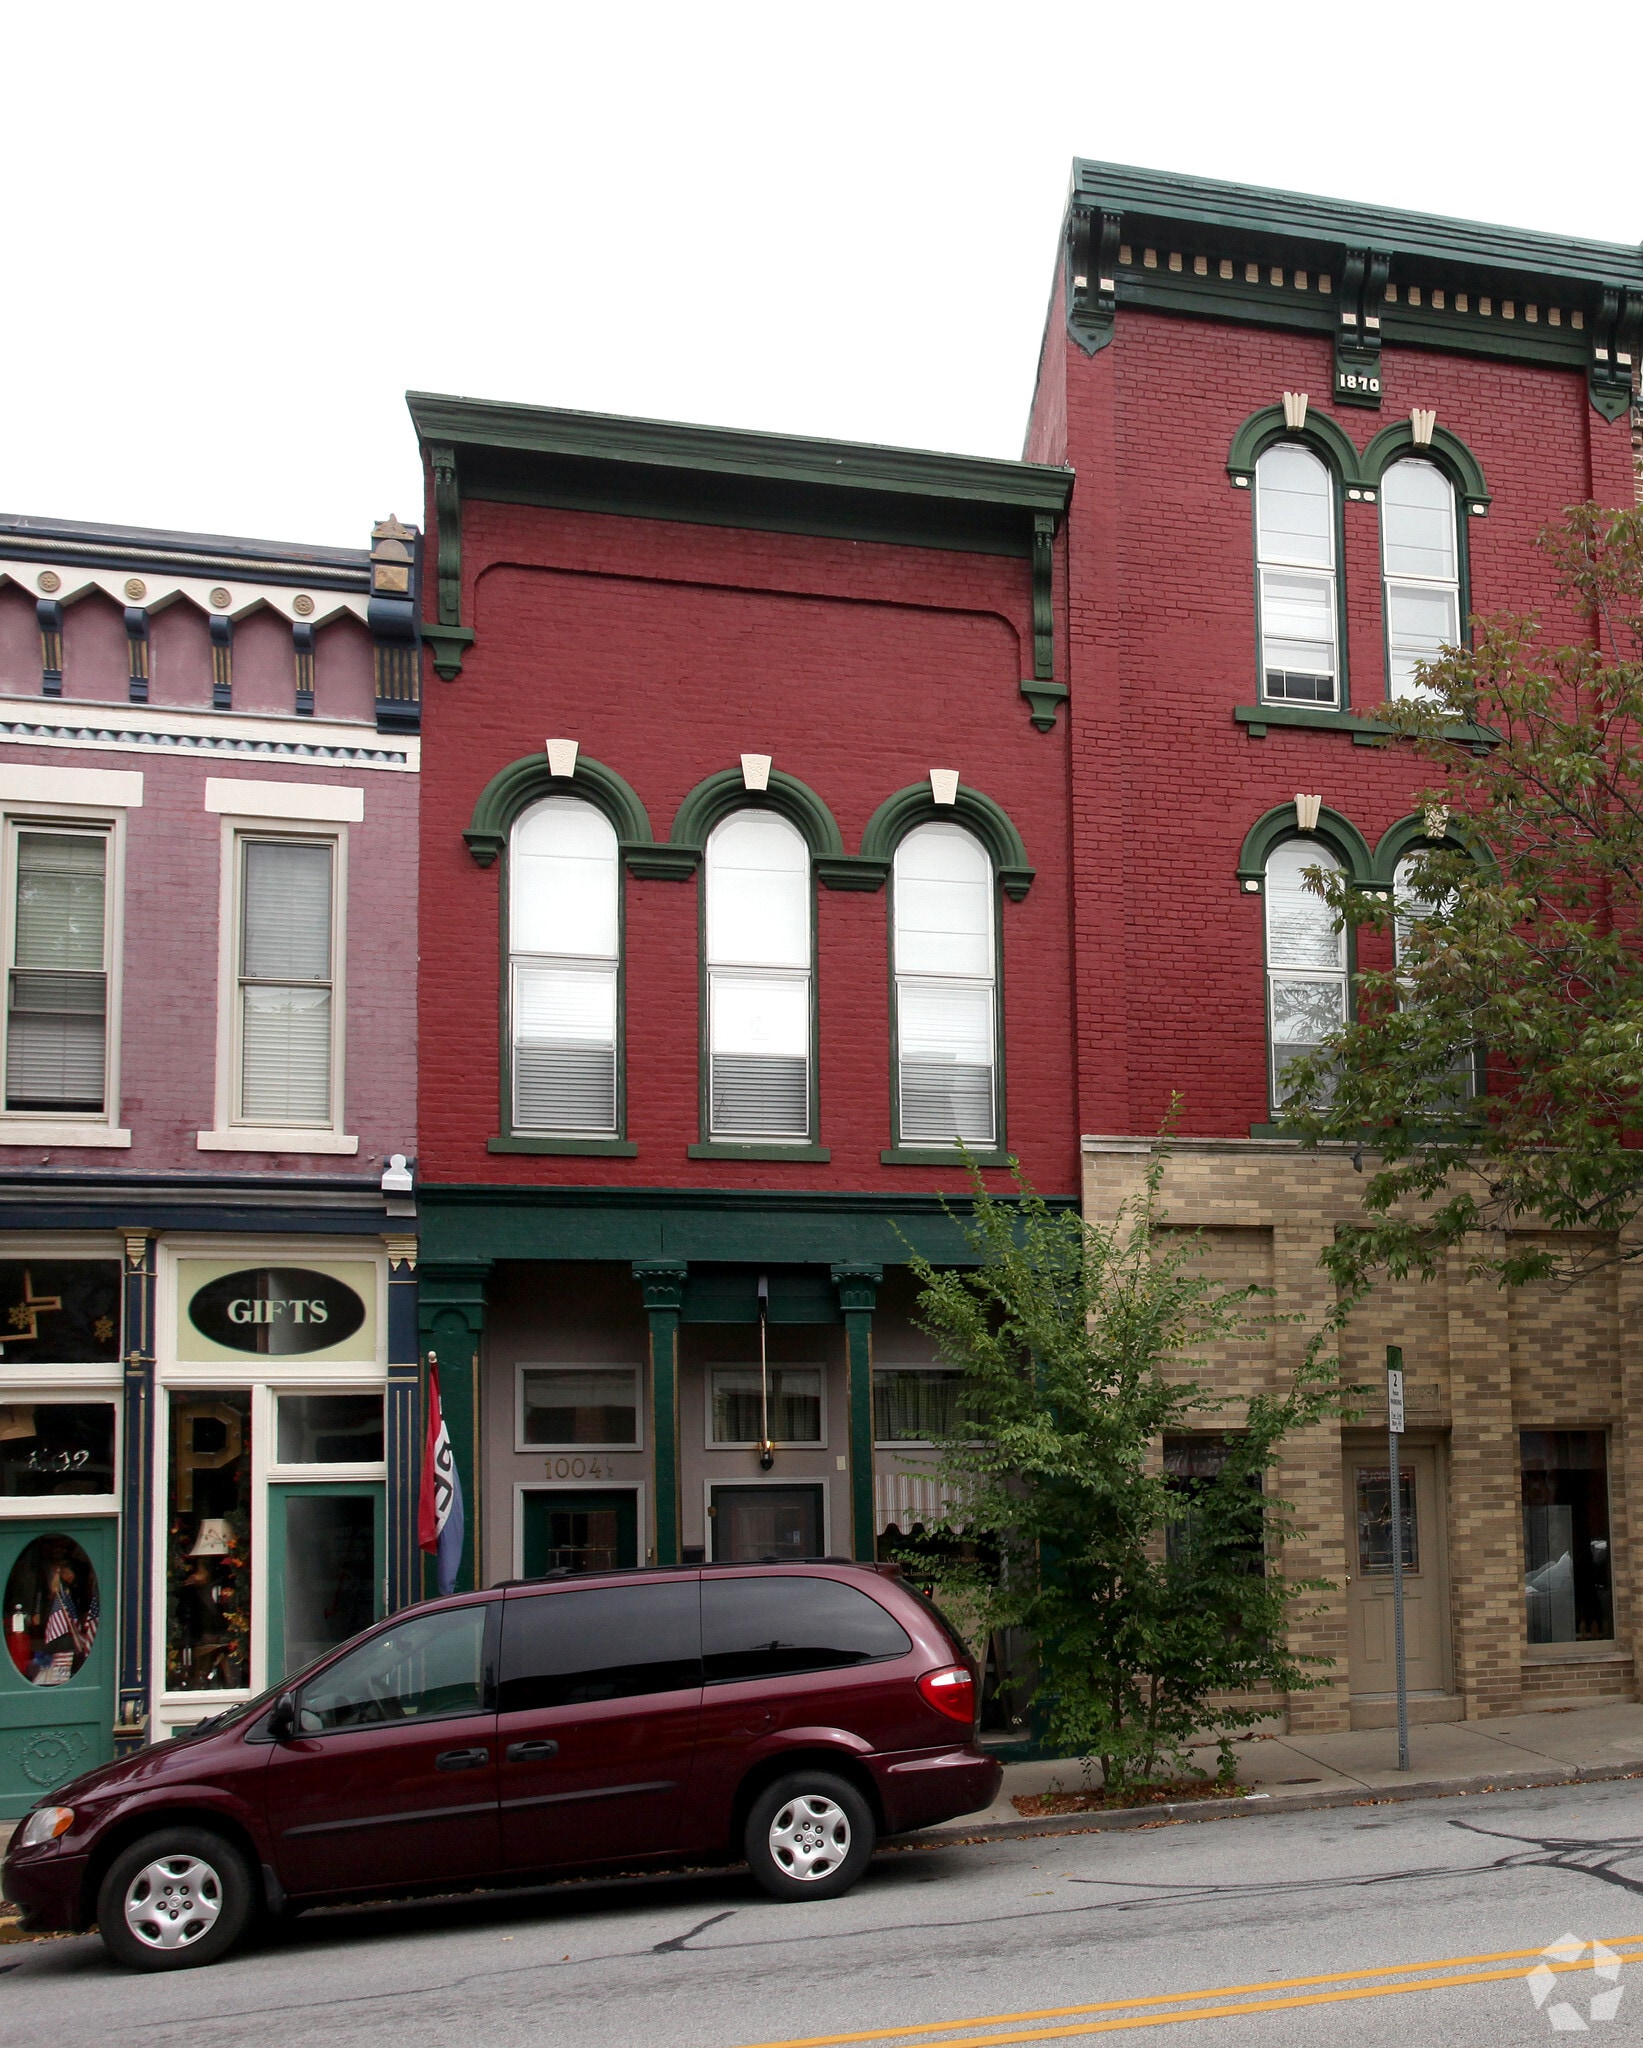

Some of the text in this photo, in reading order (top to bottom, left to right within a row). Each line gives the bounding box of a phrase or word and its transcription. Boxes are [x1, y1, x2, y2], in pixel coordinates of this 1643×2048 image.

[1340, 374, 1380, 392] 1870
[227, 1299, 328, 1324] GIFTS
[1393, 1373, 1398, 1387] 2
